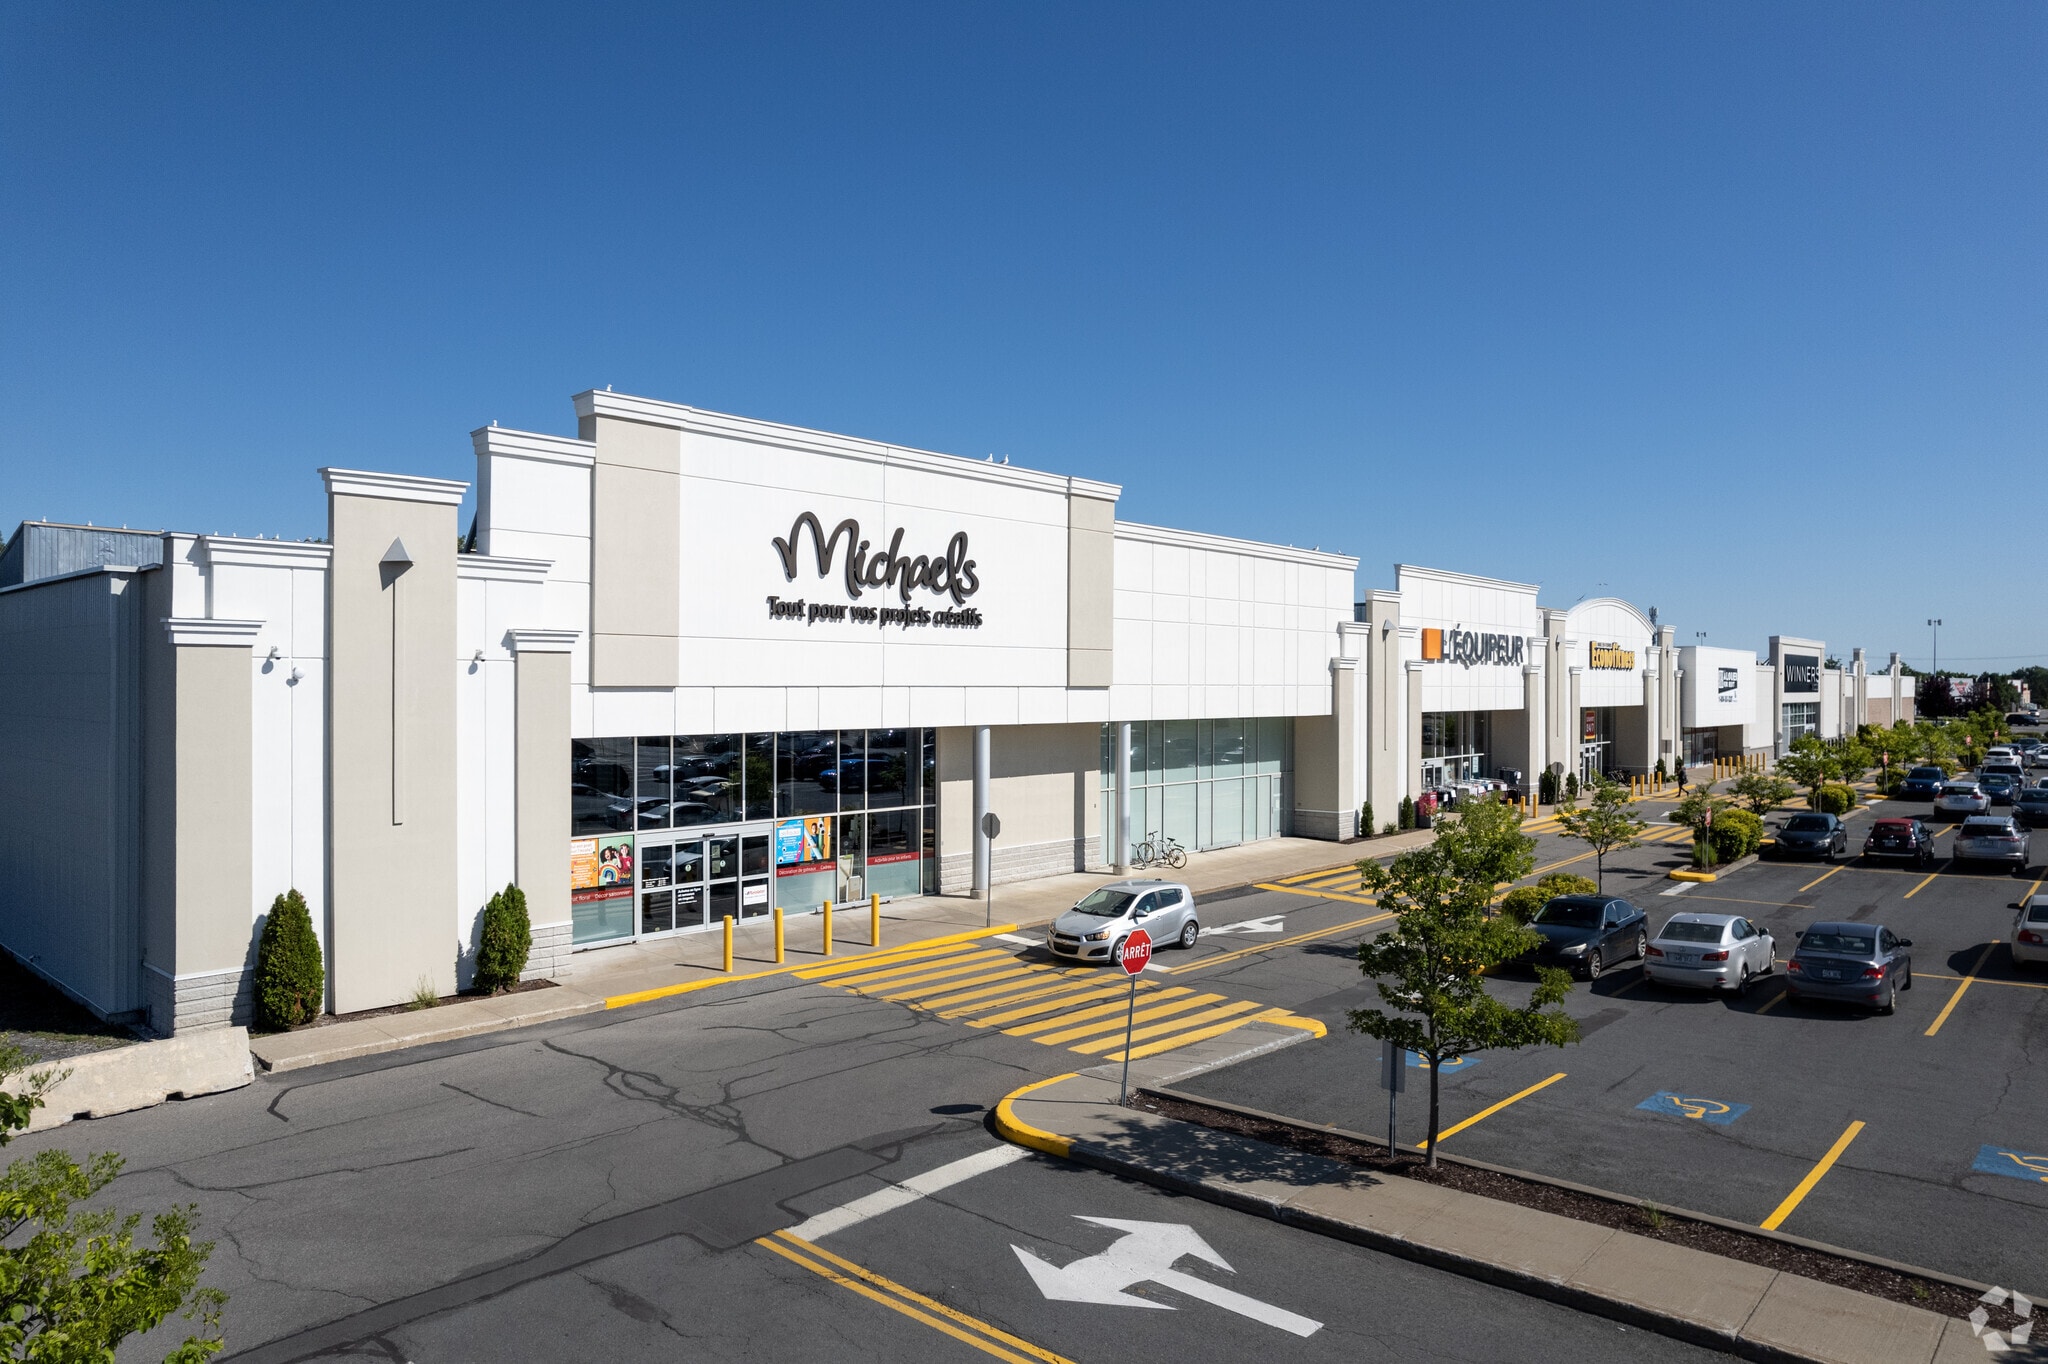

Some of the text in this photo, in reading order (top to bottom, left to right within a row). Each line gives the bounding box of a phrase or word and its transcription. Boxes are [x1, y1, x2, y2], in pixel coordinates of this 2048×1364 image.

[771, 511, 980, 605] Michaels
[767, 596, 982, 630] Tout pour vos projets créatifs
[1441, 623, 1524, 667] L'ÉQUIPEUR
[1786, 665, 1819, 683] WINNERS
[1123, 942, 1151, 961] ARRÊT
